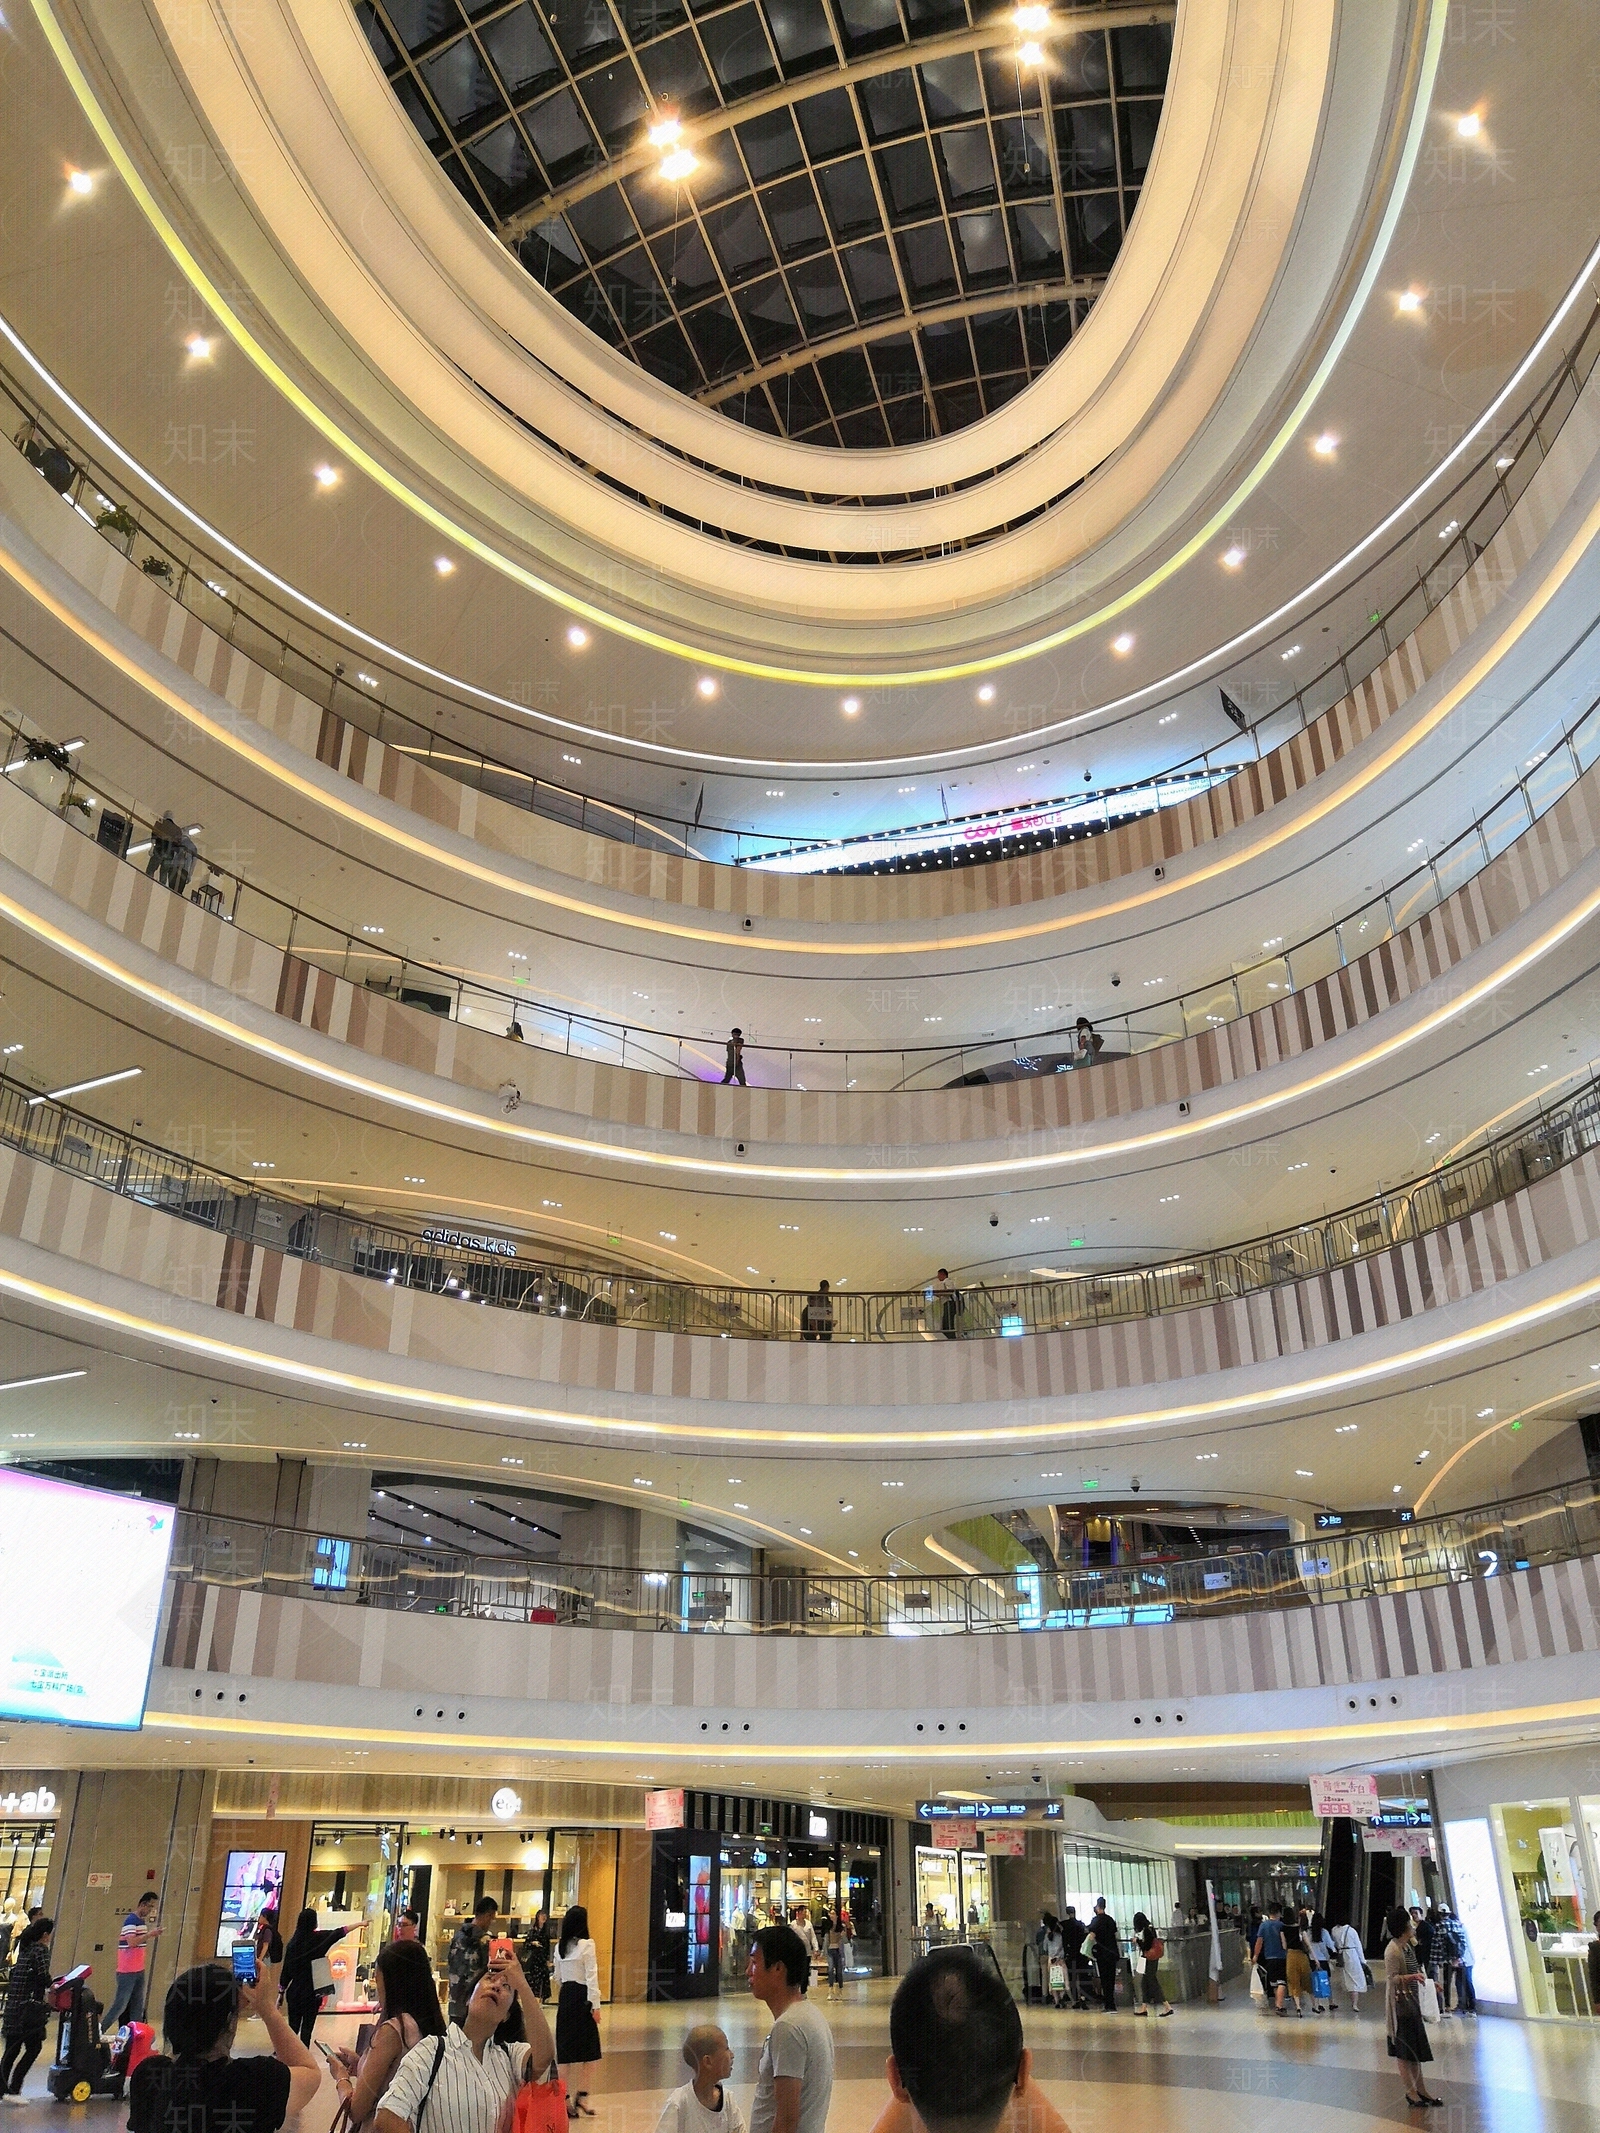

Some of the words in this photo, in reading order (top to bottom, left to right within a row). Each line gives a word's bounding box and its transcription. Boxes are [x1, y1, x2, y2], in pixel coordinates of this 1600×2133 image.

[422, 1228, 480, 1249] adidas
[484, 1236, 517, 1256] kids
[1401, 1512, 1412, 1521] 2F
[1047, 1804, 1060, 1814] 1F
